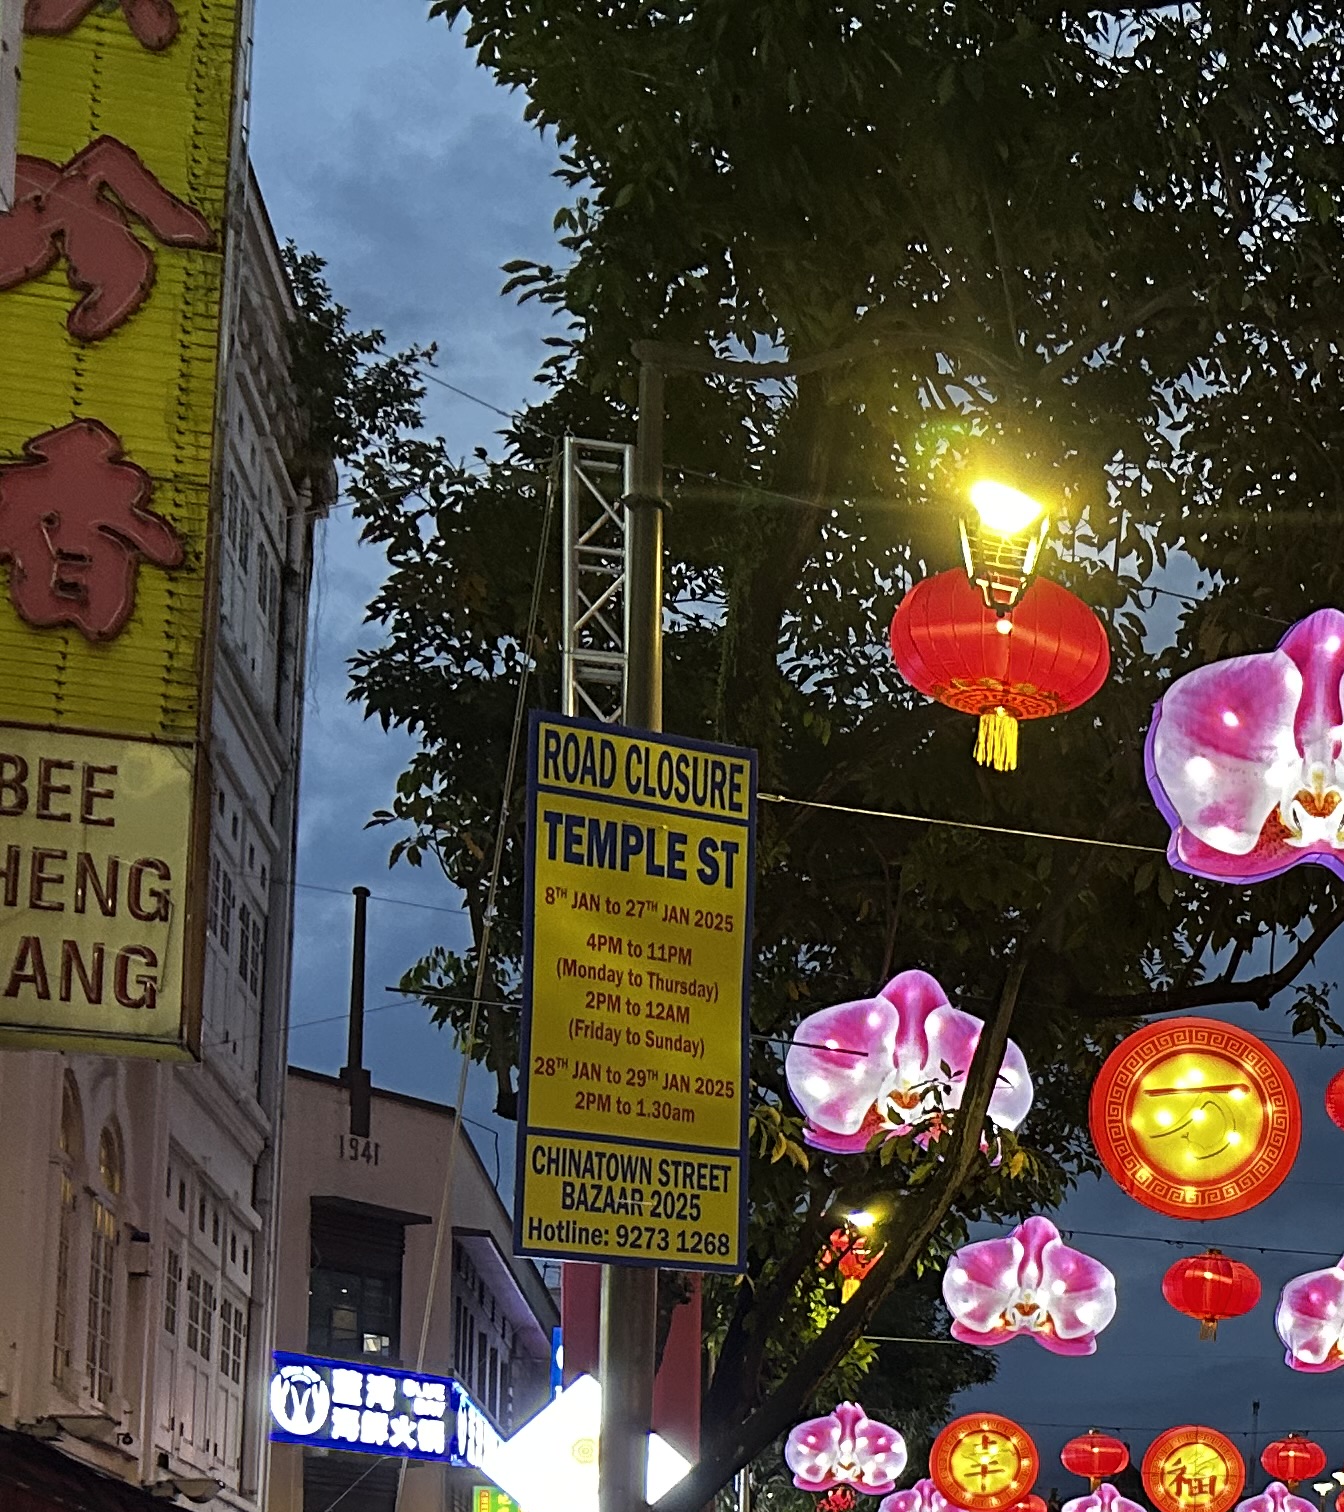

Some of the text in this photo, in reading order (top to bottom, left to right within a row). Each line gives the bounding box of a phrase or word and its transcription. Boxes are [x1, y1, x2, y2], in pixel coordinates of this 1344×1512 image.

[0, 752, 119, 827] BEE
[544, 729, 744, 812] ROAD CLOSURE
[544, 810, 739, 889] TEMPLE ST
[545, 886, 734, 933] 8TH JAN to 27TH JAN 2025
[587, 933, 692, 966] 4PM to 11PM
[556, 957, 719, 1004] (Monday to Thursday)
[585, 991, 690, 1025] 2PM to 12AM
[568, 1018, 705, 1060] (Friday to Sunday)
[534, 1056, 735, 1099] 28TH JAN to 29TH JAN 2025
[575, 1091, 695, 1123] 2PM to 1.30am
[339, 1135, 381, 1167] 1941
[532, 1145, 732, 1193] CHINATOWN STREET
[561, 1181, 701, 1222] BAZAAR 2025
[528, 1217, 730, 1256] Hotline: 9273 1268
